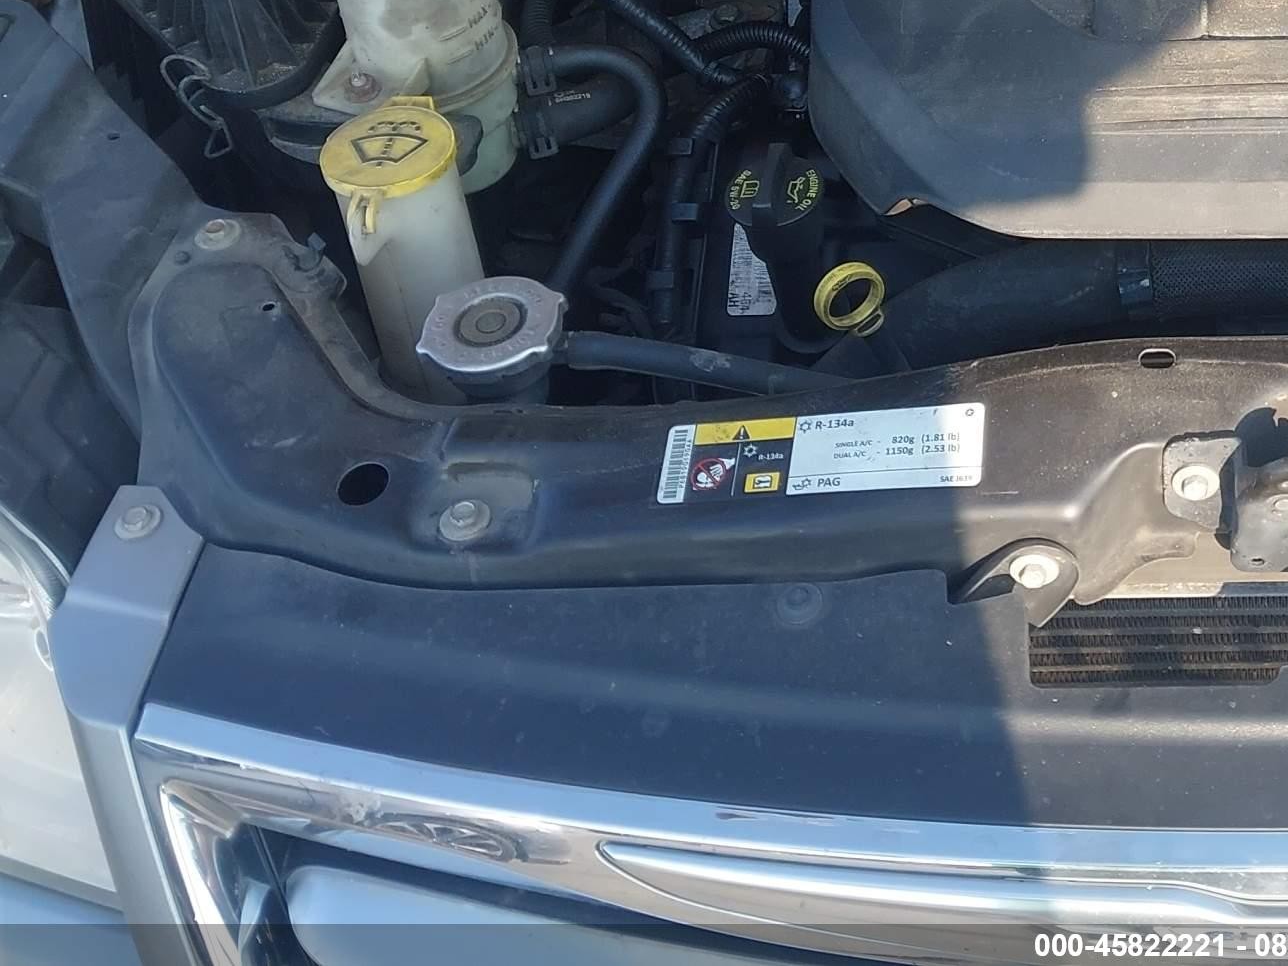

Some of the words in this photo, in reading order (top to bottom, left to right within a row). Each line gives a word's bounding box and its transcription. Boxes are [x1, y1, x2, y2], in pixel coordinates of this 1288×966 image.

[735, 170, 751, 185] SAE
[806, 169, 818, 198] ENGINE
[795, 199, 811, 210] OIL
[815, 418, 855, 430] R-134a
[891, 435, 915, 445] 820g
[921, 433, 945, 444] (1.81
[885, 446, 914, 456] 1150g
[921, 444, 945, 455] (2.53
[947, 443, 961, 454] lb)
[816, 477, 841, 488] PAG
